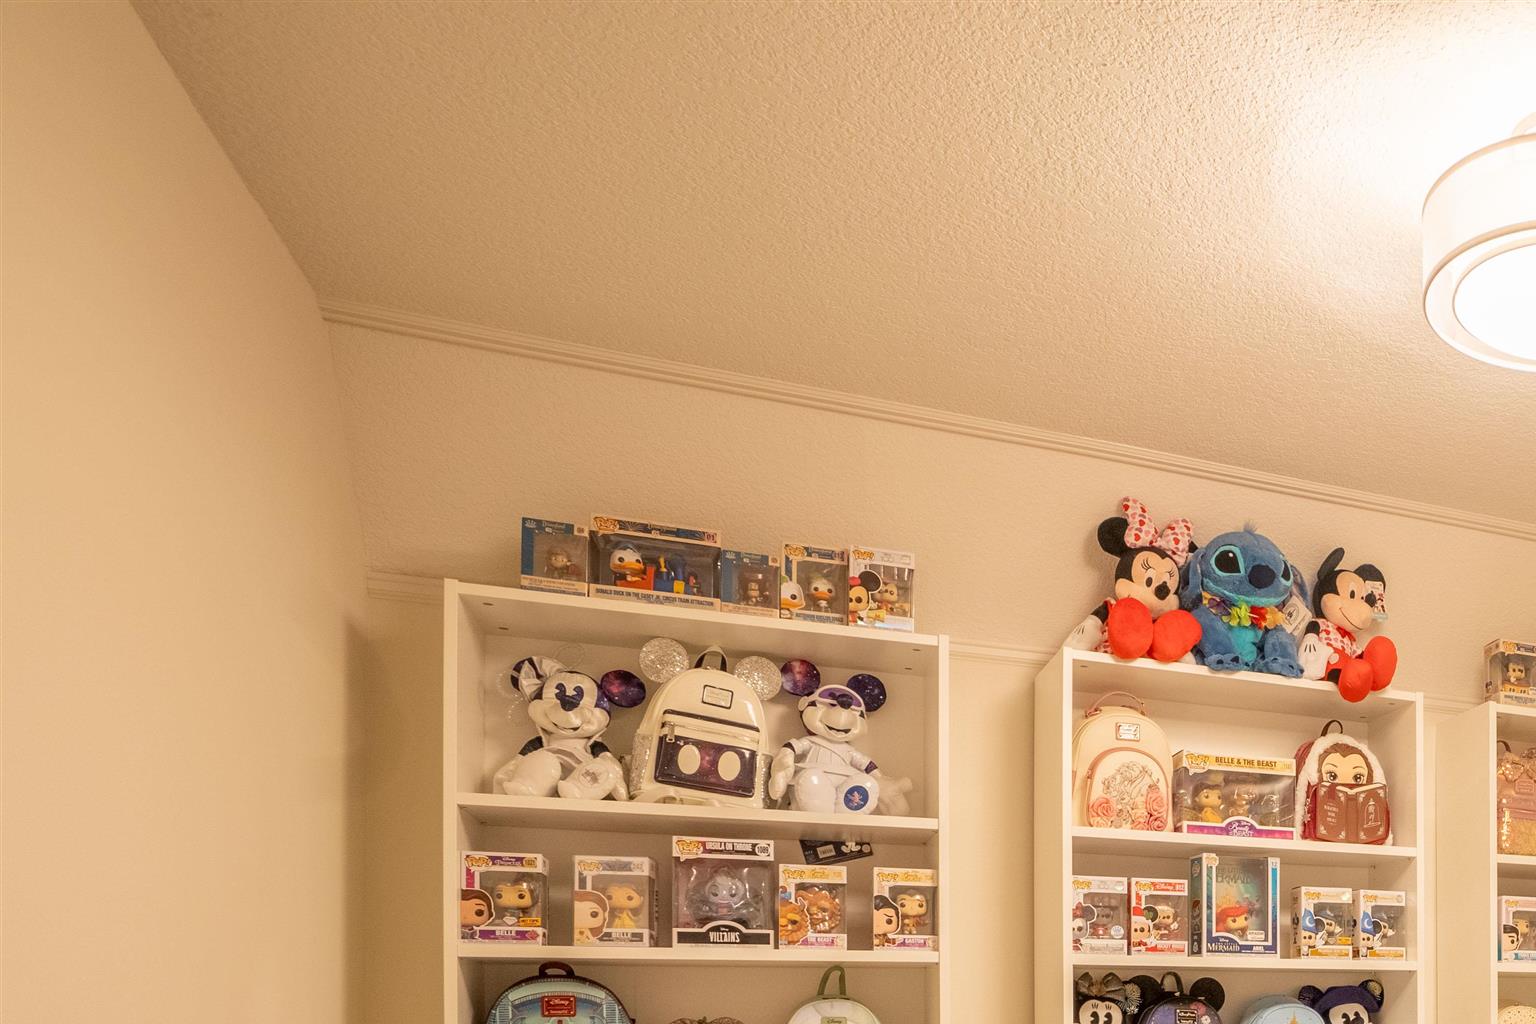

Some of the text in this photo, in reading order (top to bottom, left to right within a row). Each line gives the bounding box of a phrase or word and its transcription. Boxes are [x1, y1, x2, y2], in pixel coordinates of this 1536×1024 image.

[690, 598, 713, 606] ATTRACTION
[1215, 757, 1278, 769] BELLE & THE BEAST
[706, 841, 752, 851] URSULA ON THRONE
[757, 846, 769, 854] 1089
[709, 931, 740, 943] VILLAINS
[1207, 942, 1240, 952] MERMAID
[549, 999, 570, 1007] Disney
